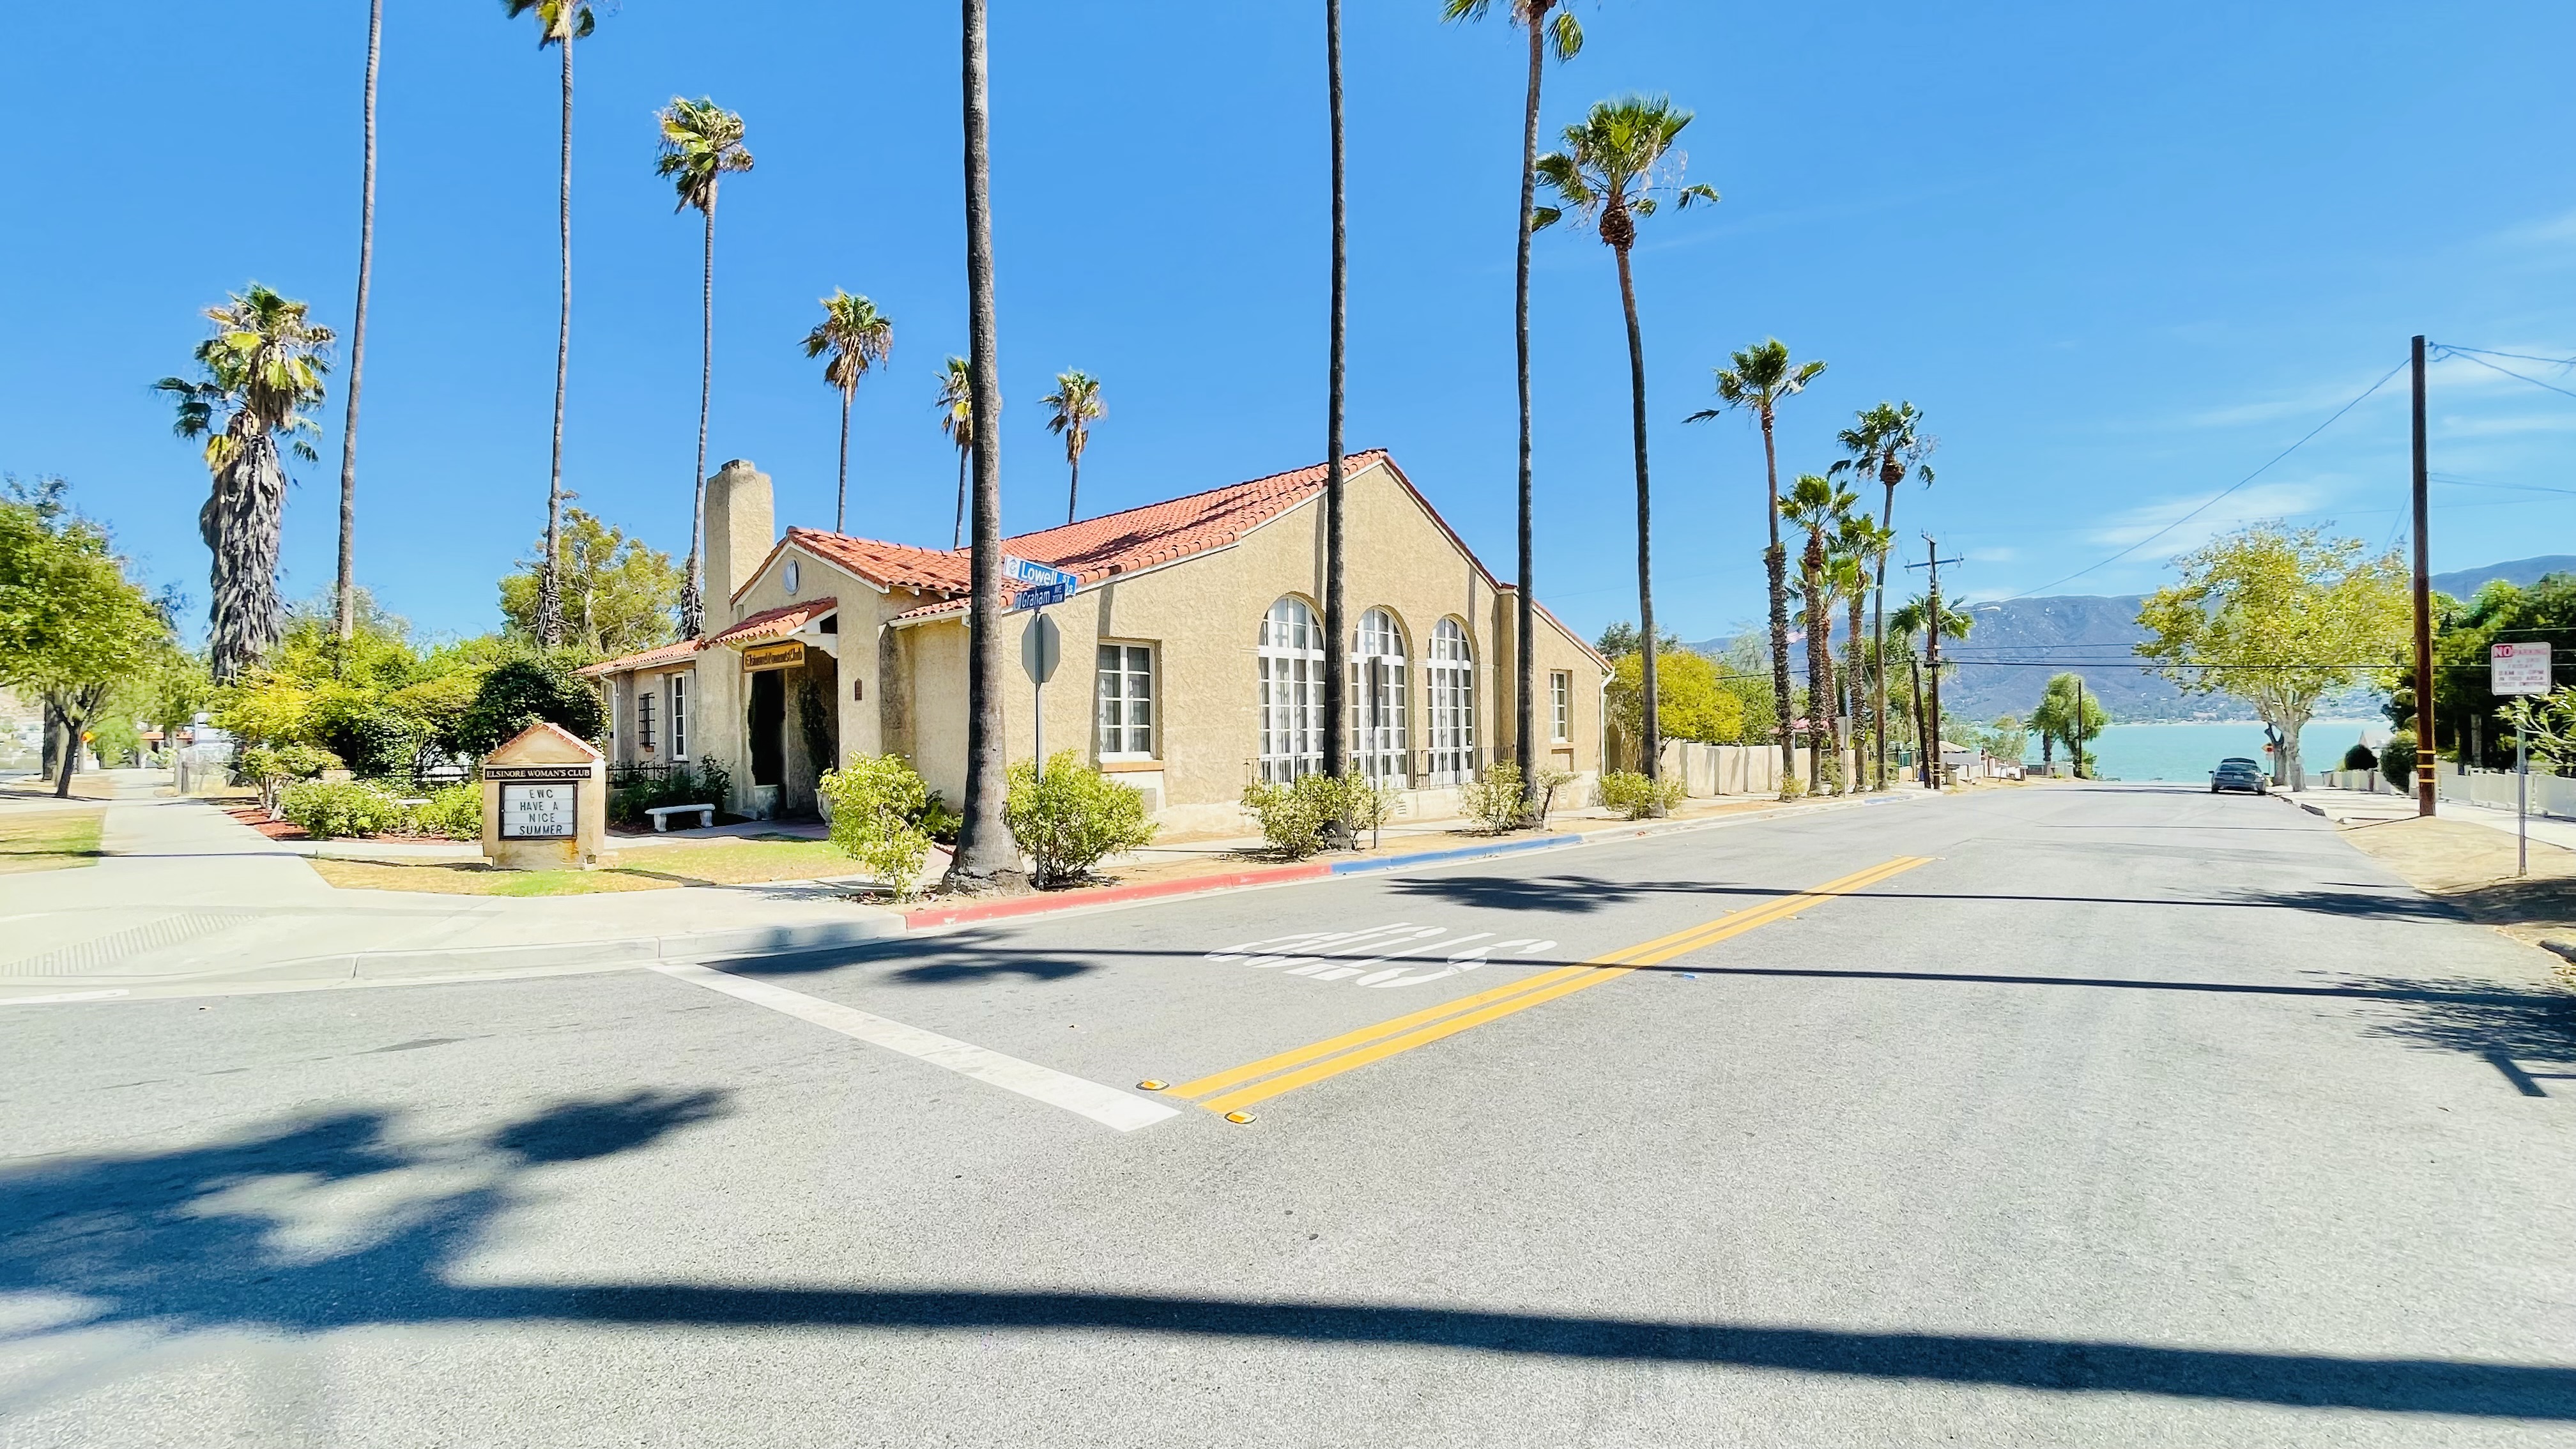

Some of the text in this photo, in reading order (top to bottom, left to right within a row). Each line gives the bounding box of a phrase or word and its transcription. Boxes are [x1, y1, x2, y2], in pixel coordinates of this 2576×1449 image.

[1021, 562, 1071, 586] Lowell ST
[1022, 585, 1062, 608] Graham AVE
[2494, 646, 2512, 657] NO
[486, 769, 590, 778] ELSINORE WOMAN'S CLUB
[530, 789, 553, 799] EWC
[520, 801, 558, 811] HAVE A
[529, 813, 555, 823] NICE
[519, 825, 562, 835] SUMMER
[1204, 922, 1558, 988] STOP
